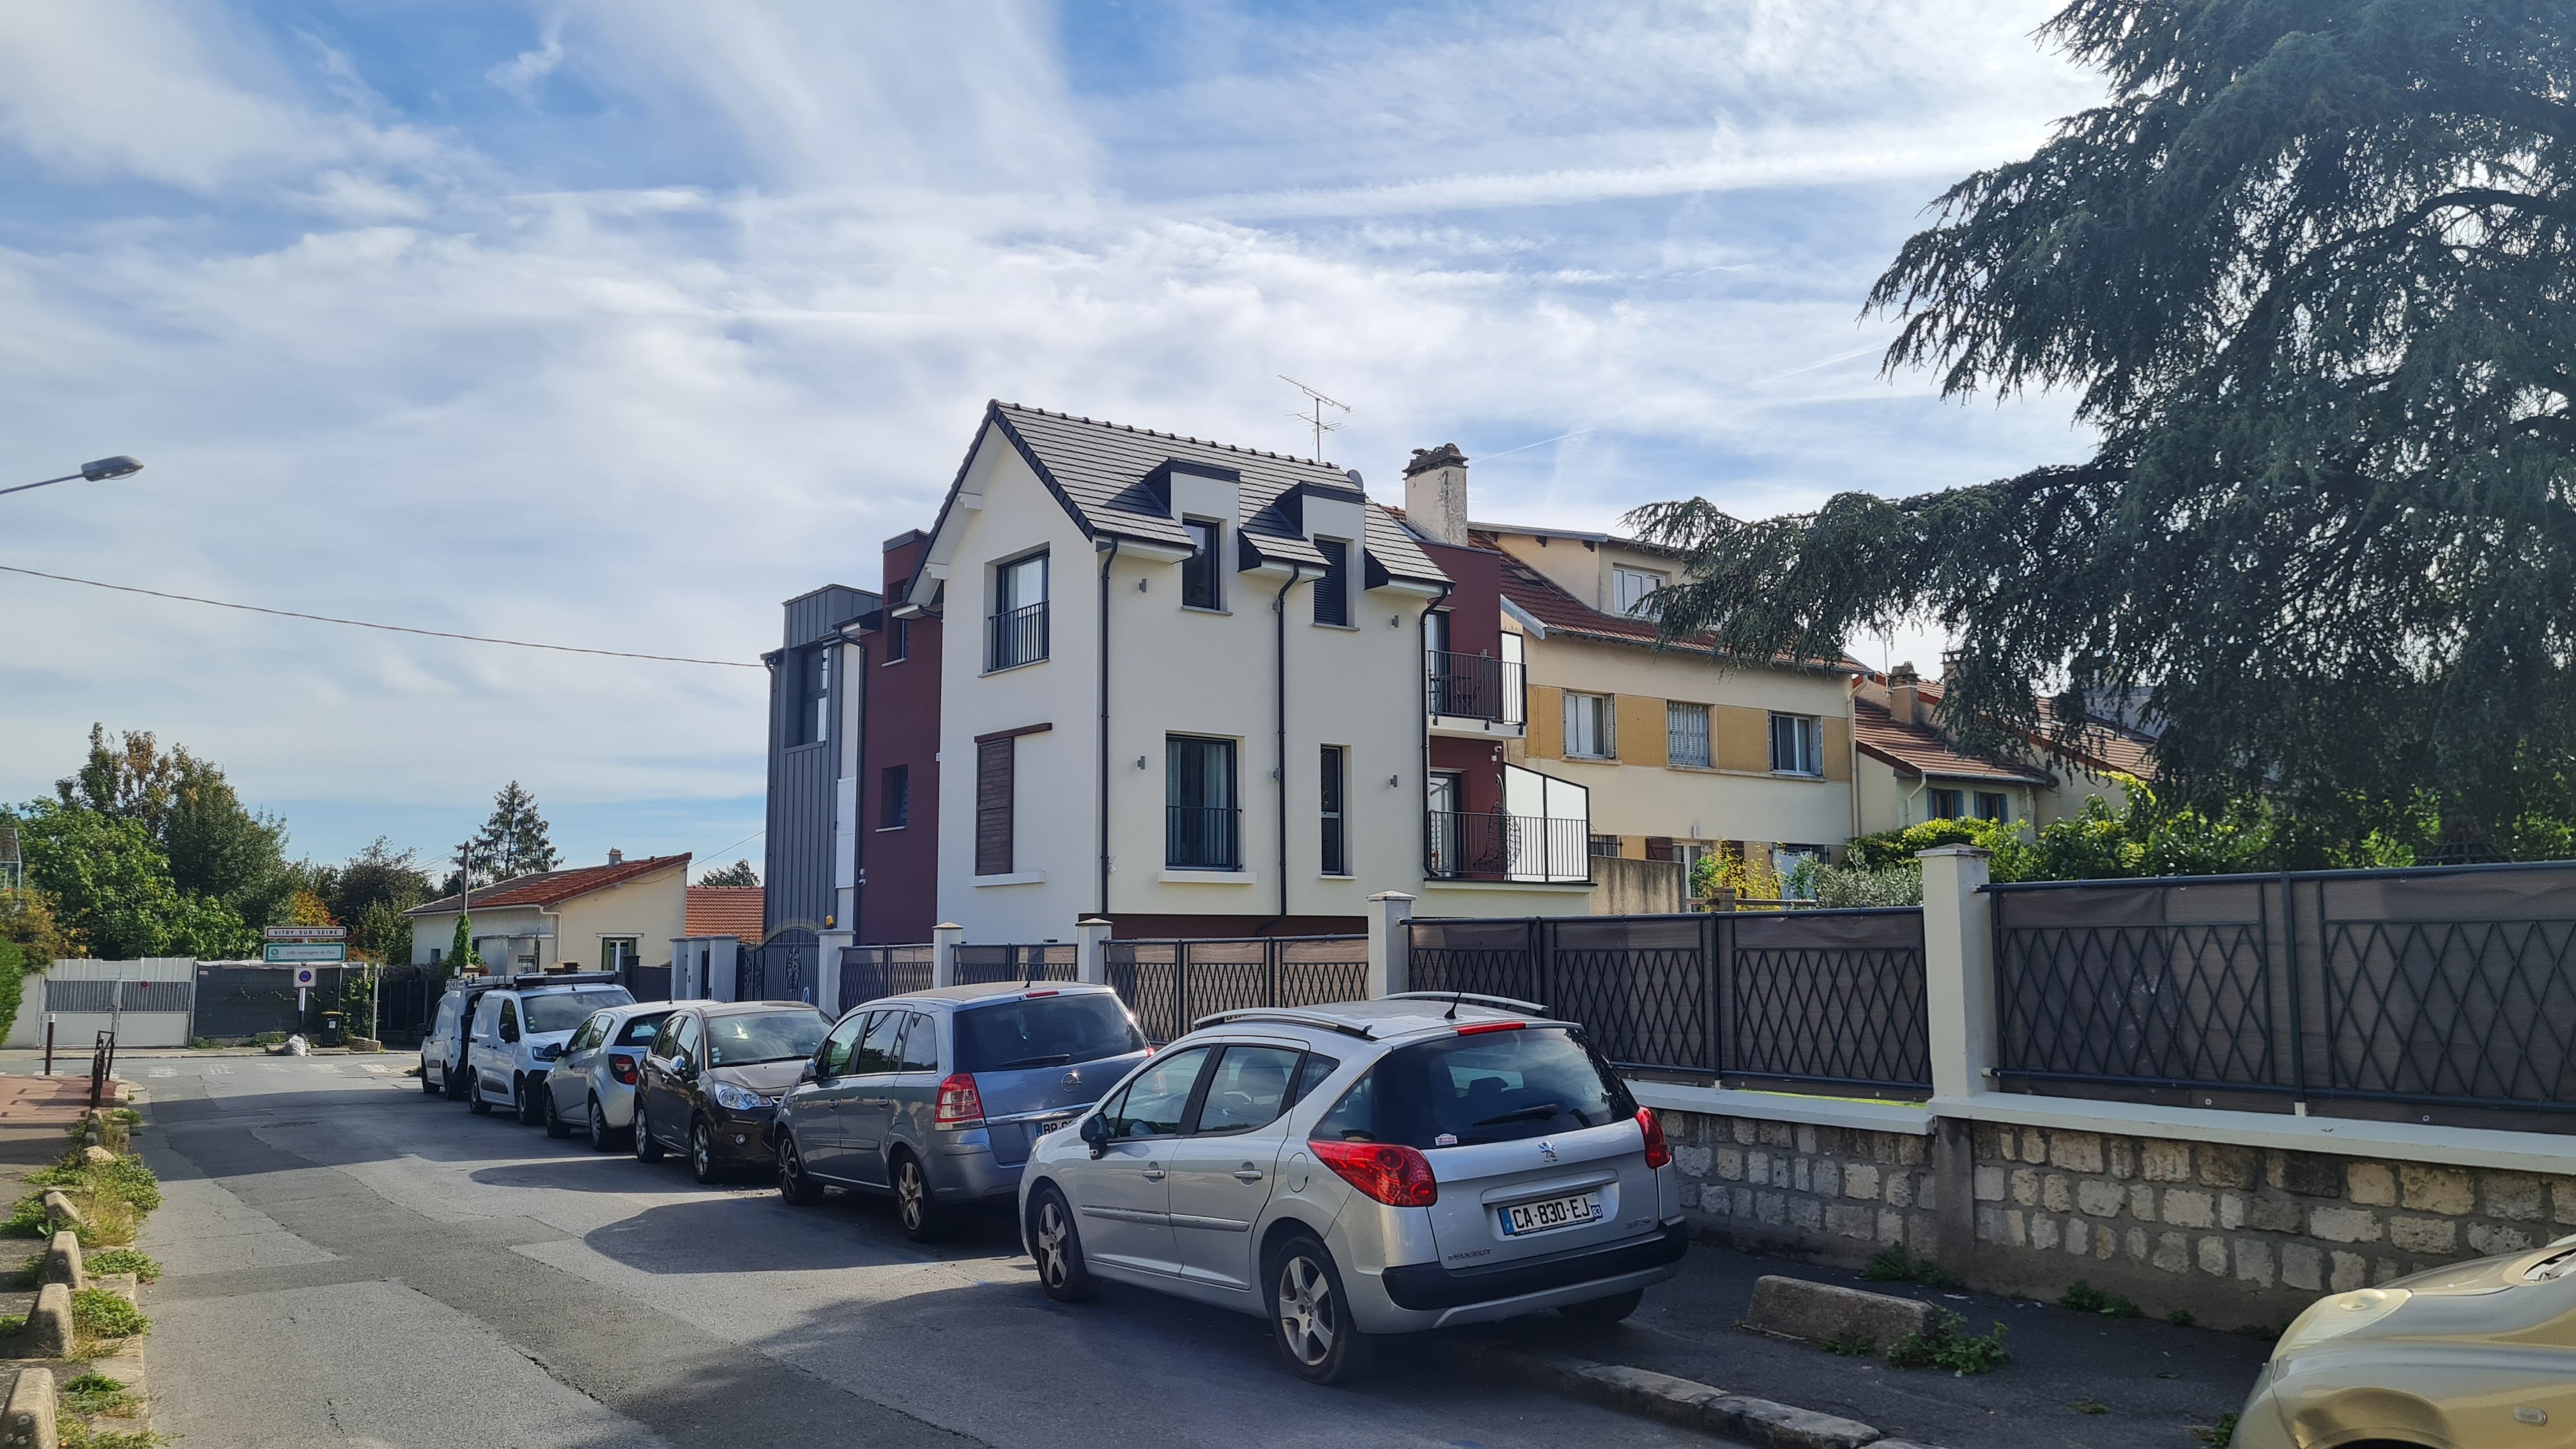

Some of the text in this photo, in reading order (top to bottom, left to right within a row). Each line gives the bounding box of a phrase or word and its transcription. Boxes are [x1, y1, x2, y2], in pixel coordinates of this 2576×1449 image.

[1512, 1197, 1590, 1229] CA-830-EJ
[1591, 1206, 1601, 1217] 83
[1448, 1248, 1491, 1261] PEUGEOT
